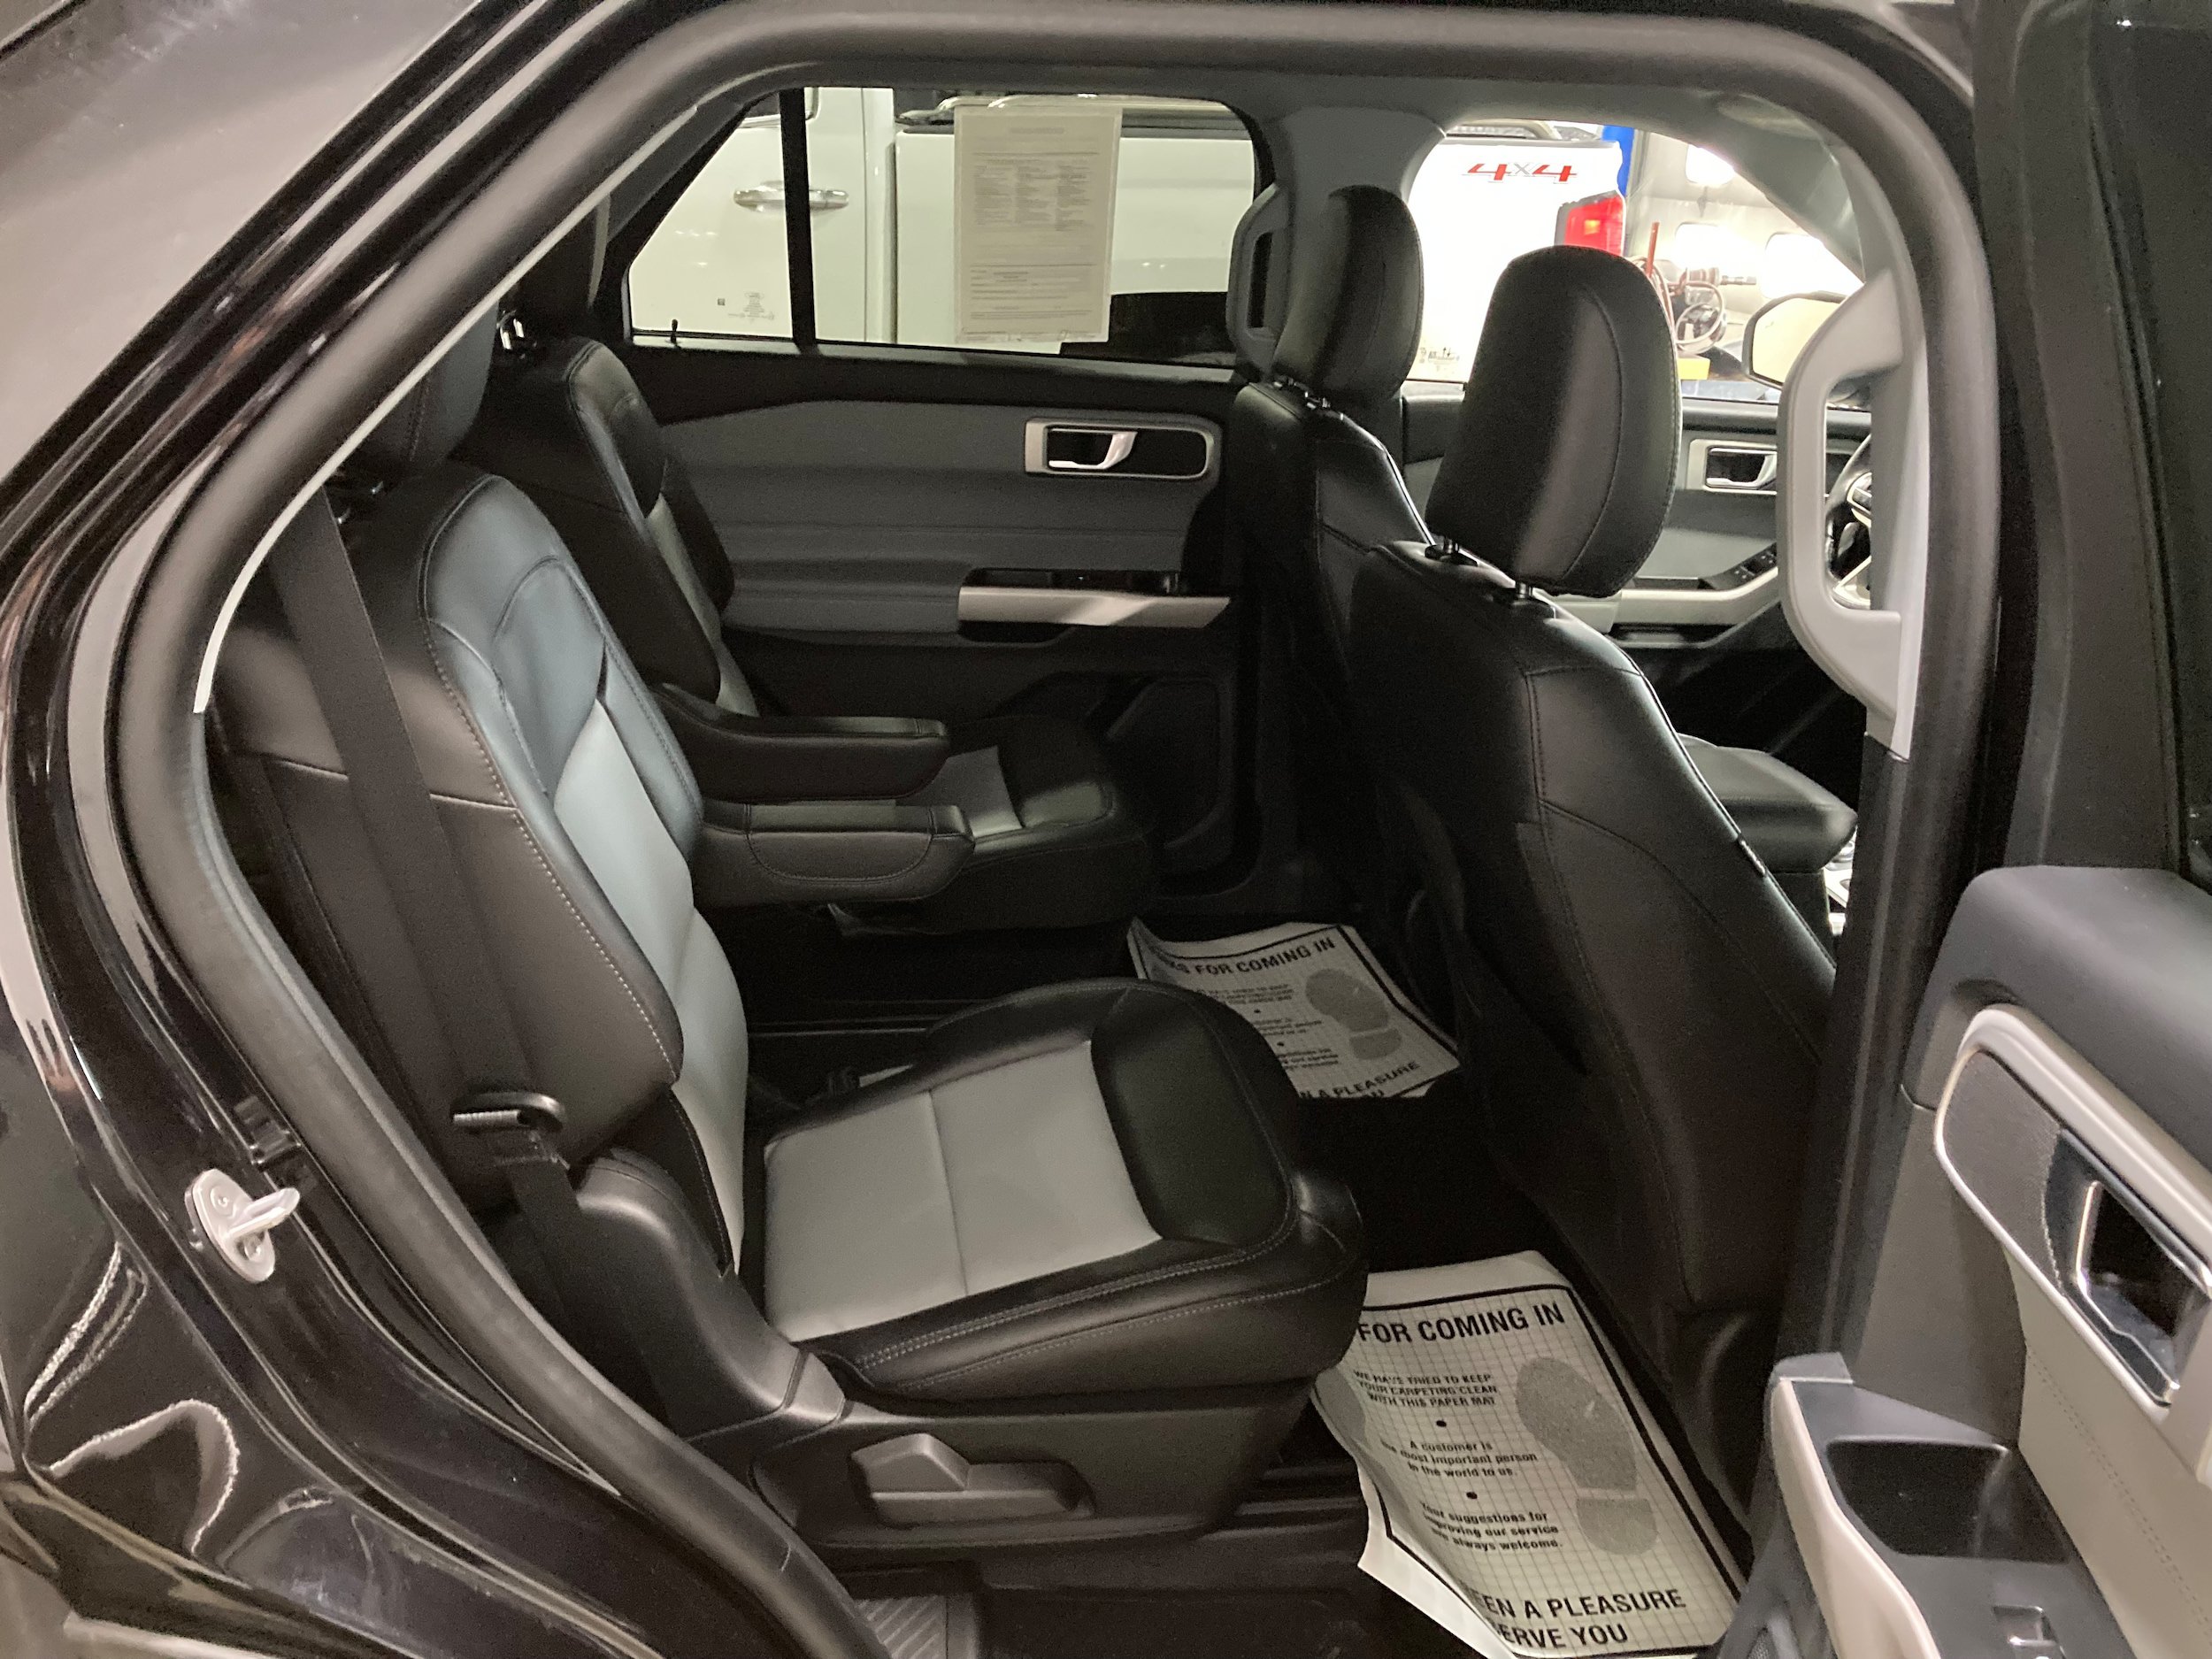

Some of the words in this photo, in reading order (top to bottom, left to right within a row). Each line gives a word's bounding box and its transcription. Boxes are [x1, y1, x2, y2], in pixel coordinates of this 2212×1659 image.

[1194, 963, 1232, 975] FOR
[1236, 944, 1311, 973] COMING
[1313, 936, 1336, 954] IN
[1332, 1061, 1421, 1096] PLEASURE
[1357, 1322, 1413, 1343] FOR
[1417, 1307, 1529, 1342] COMING
[1532, 1301, 1565, 1326] IN
[1407, 1375, 1441, 1386] TRIED
[1444, 1375, 1460, 1385] TO
[1463, 1373, 1492, 1384] KEEP
[1391, 1386, 1457, 1396] CARPETING
[1459, 1385, 1498, 1394] CLEAN
[1366, 1391, 1398, 1407] WITH
[1400, 1396, 1427, 1408] THIS
[1430, 1396, 1470, 1407] PAPER
[1471, 1395, 1496, 1406] MAT
[1409, 1440, 1419, 1450] A
[1421, 1441, 1478, 1453] customer
[1432, 1454, 1493, 1466] important
[1495, 1452, 1539, 1465] person
[1421, 1464, 1440, 1477] the
[1444, 1466, 1479, 1478] world
[1482, 1467, 1495, 1477] to
[1448, 1512, 1525, 1525] suggestions
[1528, 1511, 1548, 1523] for
[1485, 1527, 1506, 1537] our
[1510, 1524, 1559, 1536] service
[1453, 1535, 1496, 1551] always
[1499, 1539, 1563, 1550] welcome.
[1524, 1599, 1543, 1619] A
[1547, 1588, 1686, 1618] PLEASURE
[1570, 1623, 1629, 1646] YOU
